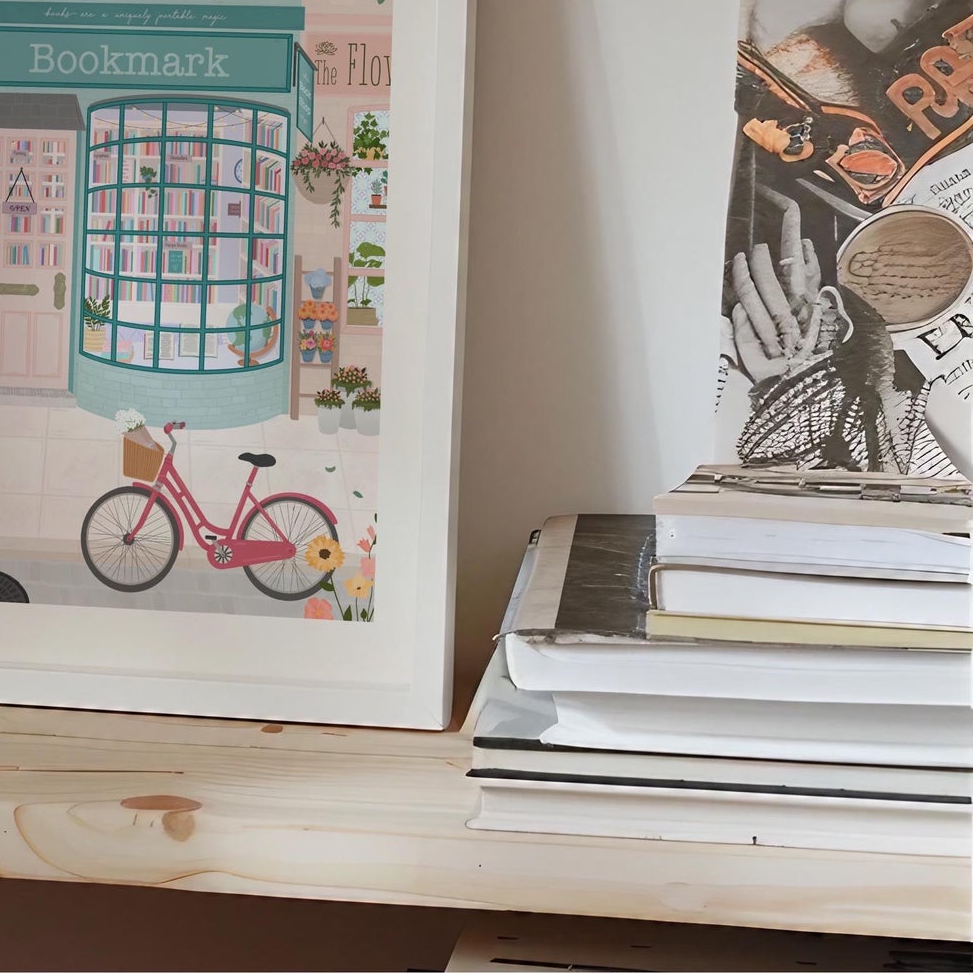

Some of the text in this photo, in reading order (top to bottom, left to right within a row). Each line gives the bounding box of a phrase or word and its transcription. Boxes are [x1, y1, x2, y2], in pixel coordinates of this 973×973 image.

[114, 8, 152, 26] uniquely
[155, 9, 196, 26] portable
[201, 13, 228, 28] magic
[29, 42, 230, 79] Bookmark
[314, 59, 338, 86] The
[9, 204, 31, 212] OPEN
